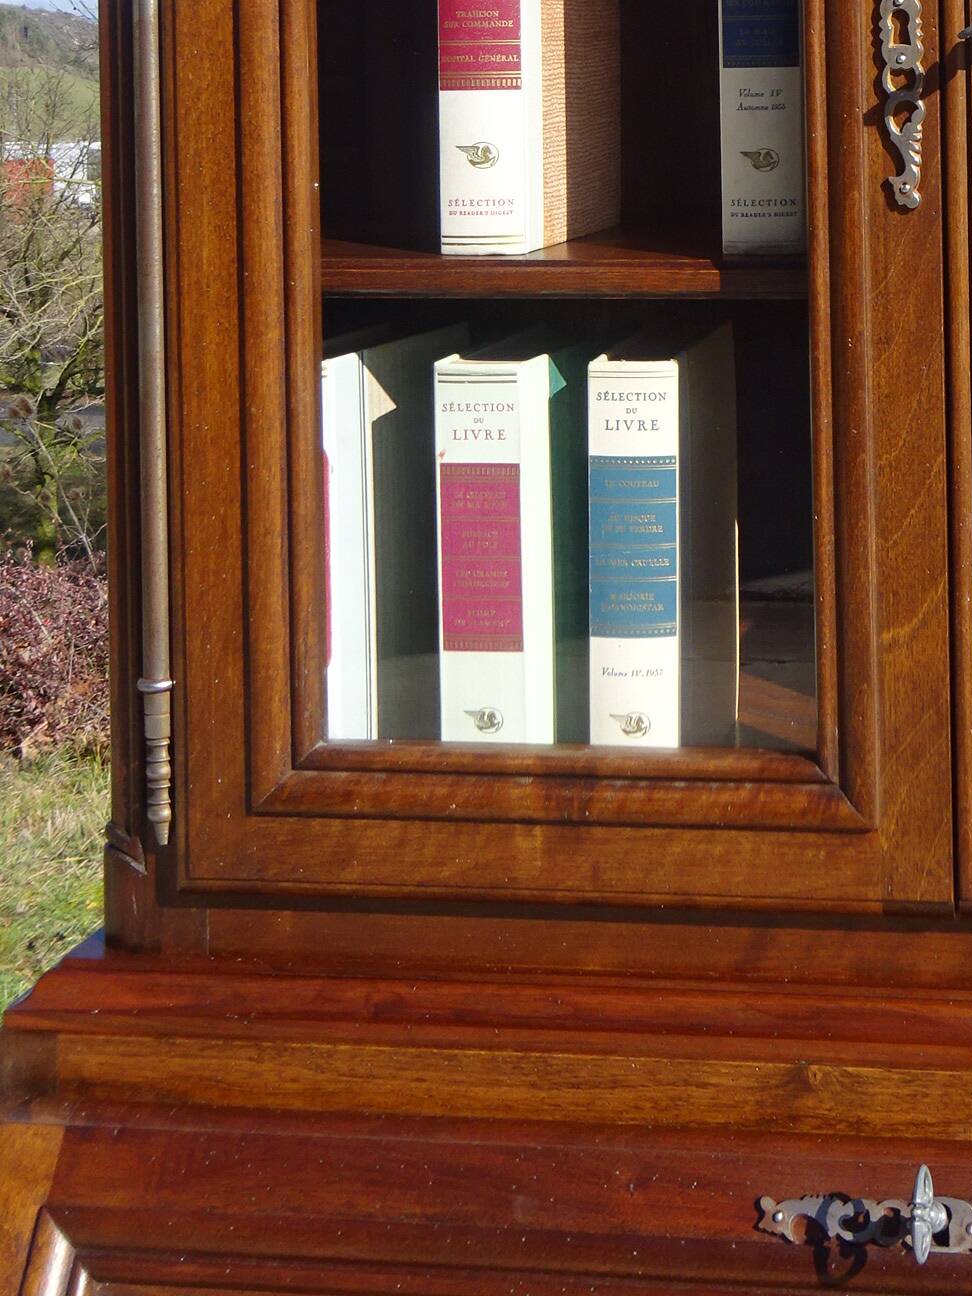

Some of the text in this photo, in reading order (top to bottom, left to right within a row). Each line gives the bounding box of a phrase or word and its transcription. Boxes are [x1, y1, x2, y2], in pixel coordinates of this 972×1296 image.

[462, 20, 514, 28] COMMANDE
[448, 198, 515, 207] SÉLECTION
[730, 198, 797, 207] SÉLECTION
[596, 390, 667, 401] SÉLECTION
[441, 402, 515, 412] SÉLECTION
[605, 419, 660, 431] LIVRE
[452, 429, 506, 440] LIVRE
[601, 666, 628, 677] Volume
